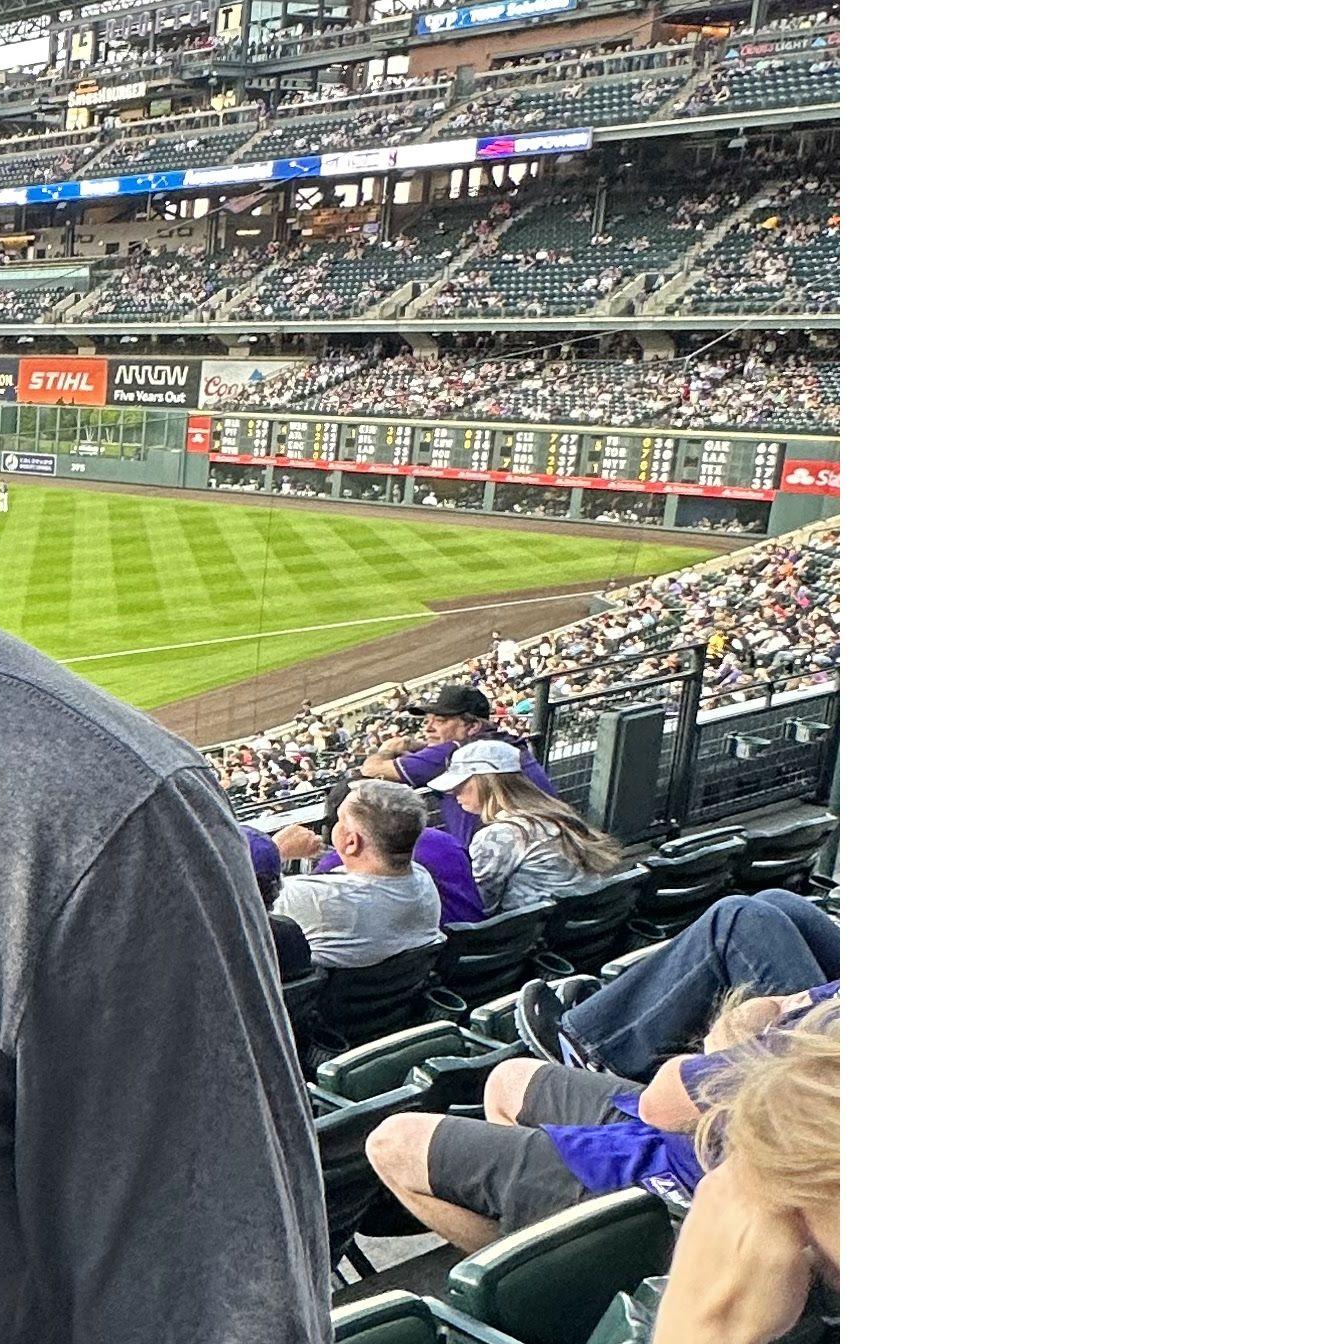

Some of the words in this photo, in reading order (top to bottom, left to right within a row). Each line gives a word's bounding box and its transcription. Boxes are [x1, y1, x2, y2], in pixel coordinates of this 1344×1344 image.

[775, 39, 809, 51] LIGHT
[28, 370, 96, 392] STIHL
[114, 364, 190, 386] ARROW
[113, 389, 136, 403] Five
[136, 390, 164, 403] Years
[164, 391, 187, 404] Out
[703, 440, 732, 452] OAK
[641, 448, 650, 459] 7
[638, 471, 647, 482] 4
[755, 466, 776, 478] 17
